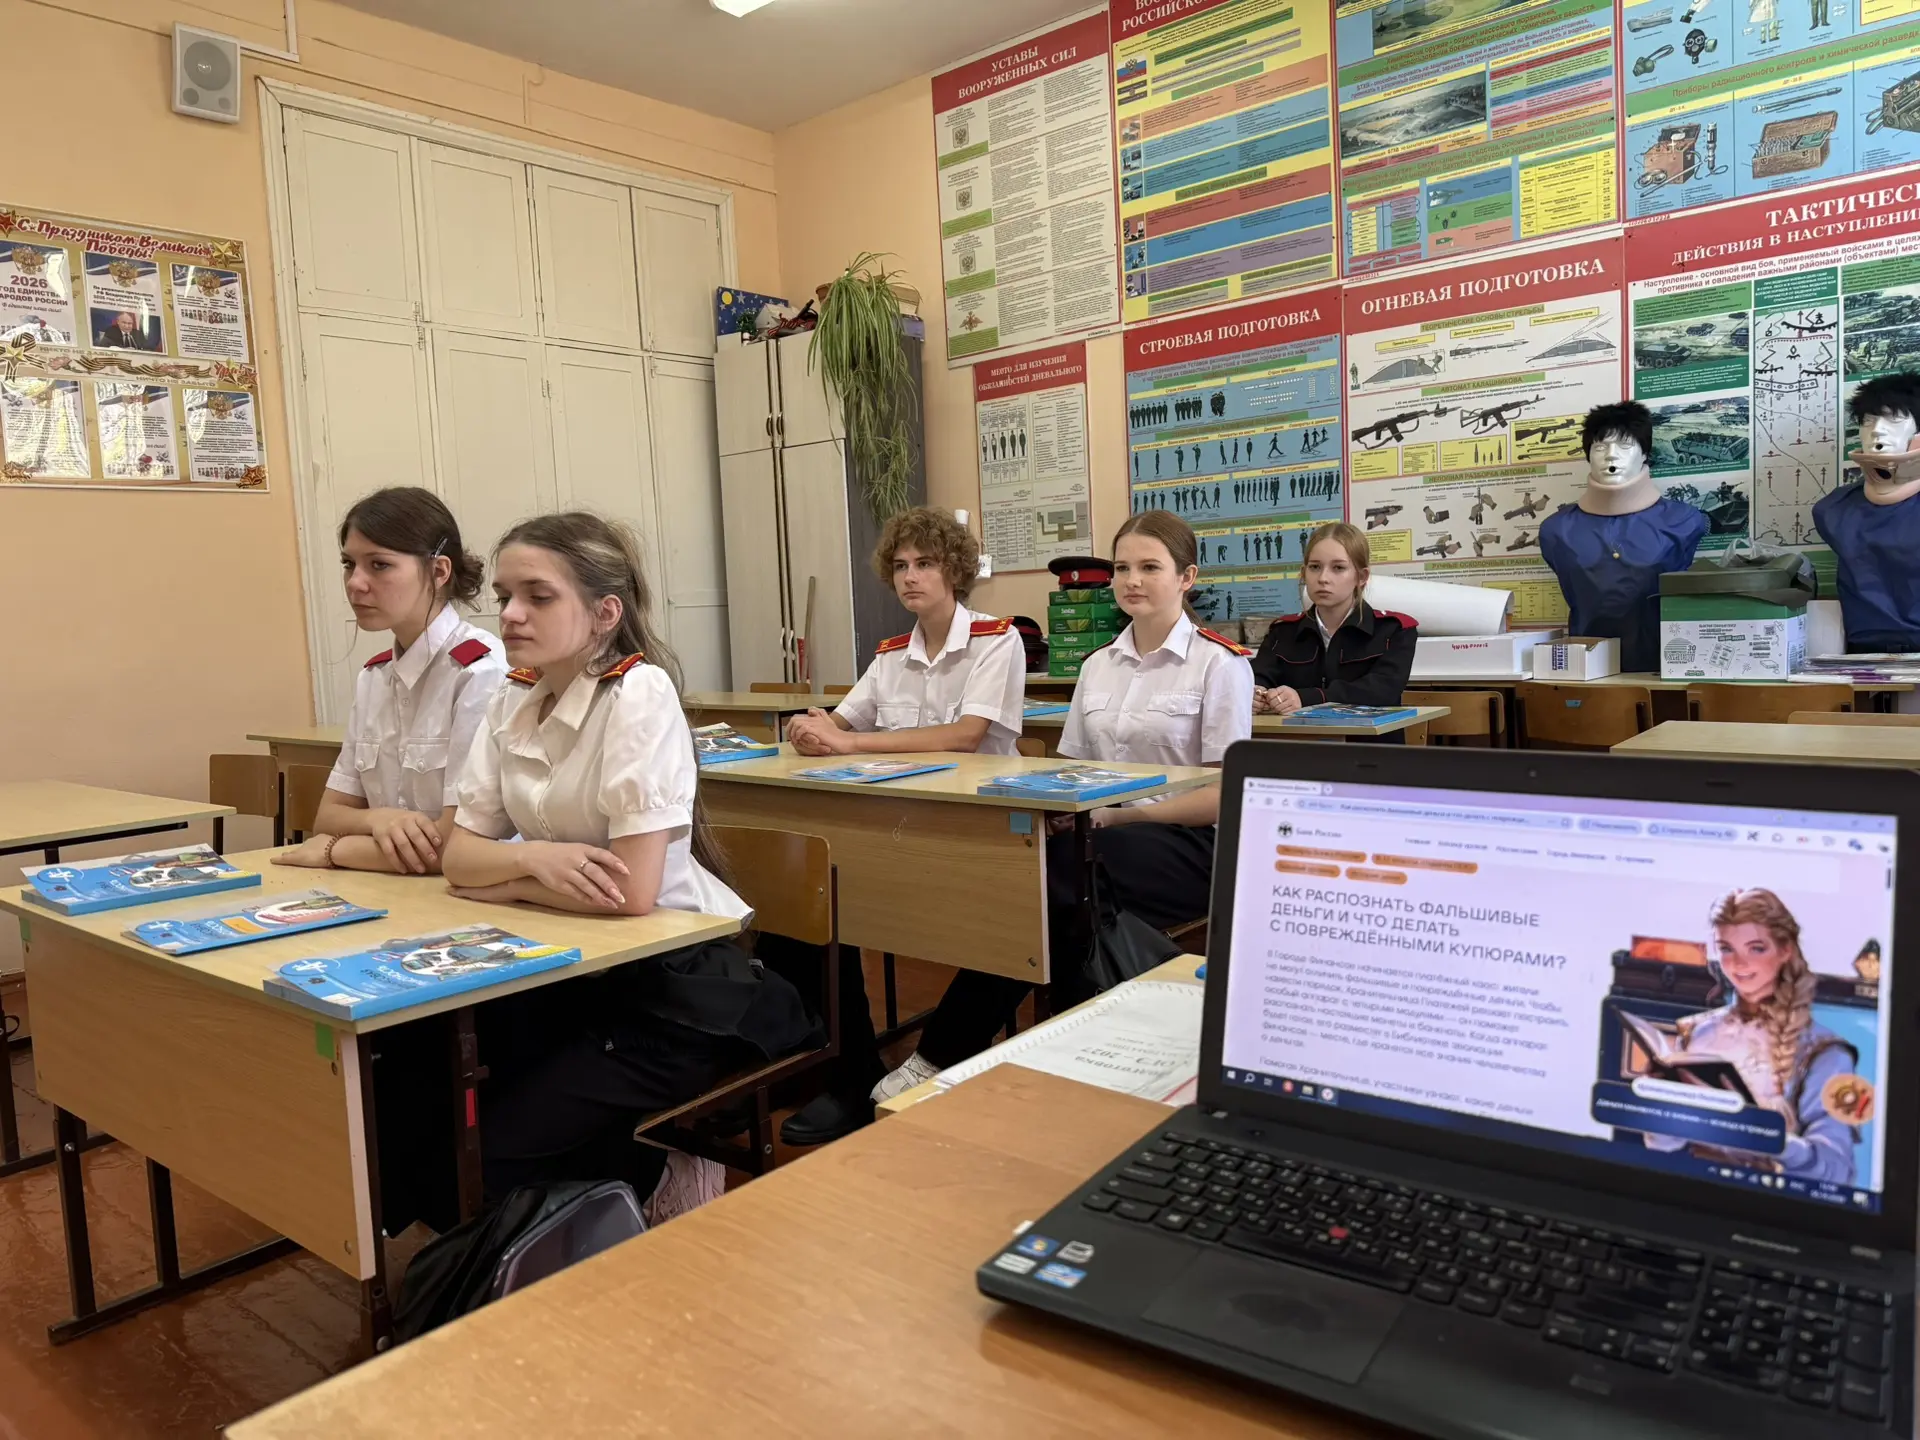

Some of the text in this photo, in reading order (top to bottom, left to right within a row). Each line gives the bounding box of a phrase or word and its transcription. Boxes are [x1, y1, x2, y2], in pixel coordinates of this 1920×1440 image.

[1121, 0, 1207, 31] РОССИЙСК
[958, 47, 1077, 99] ВООРУЖЕННЫХ СИЛ
[991, 46, 1039, 72] УСТАВЫ
[1672, 80, 1708, 97] Приборы
[1711, 64, 1774, 88] радиационного
[1819, 53, 1823, 62] и
[1826, 40, 1879, 61] химической
[37, 220, 135, 245] Праздником
[139, 234, 206, 257] Великой
[86, 239, 155, 259] Победы!
[1671, 238, 1763, 265] ДЕЙСТВИЯ
[1769, 234, 1781, 246] В
[1643, 273, 1692, 290] Наступление
[1700, 265, 1738, 280] основной
[1741, 262, 1755, 273] вид
[1758, 259, 1775, 270] боя,
[1778, 248, 1838, 266] применяемый
[1841, 240, 1882, 256] войсками
[1885, 239, 1891, 248] в
[1657, 279, 1702, 295] противника
[1705, 278, 1710, 287] и
[1712, 270, 1755, 286] овладения
[1758, 263, 1797, 278] важными
[1799, 255, 1841, 271] районами
[1844, 245, 1898, 263] (объектами)
[10, 275, 48, 289] 2026
[1361, 258, 1605, 315] ОГНЕВАЯ ПОДГОТОВКА
[35, 297, 68, 306] РОССИИ
[1140, 308, 1321, 355] СТРОЕВАЯ ПОДГОТОВКА
[1422, 316, 1474, 332] ТЕОРЕТИЧЕСКИЕ
[1476, 311, 1504, 324] ОСНОВЫ
[1506, 306, 1544, 319] СТРЕЛЬБЫ
[991, 354, 1067, 377] МЕСТО ДЛЯ ИЗУЧЕНИЯ
[1032, 365, 1082, 382] ДНЕВАЛЬНОГО
[1440, 376, 1522, 392] АВТОМАТ КАЛАШНИКОВА
[1428, 473, 1461, 483] НЕПОЛНАЯ
[1463, 470, 1498, 480] РАЗБОРКА
[1500, 467, 1536, 478] АВТОМАТА
[1271, 903, 1460, 938] ДЕНЬГИ И ЧТО ДЕЛАТЬ
[1272, 885, 1540, 928] КАК РАСПОЗНАТЬ ФАЛЬШИВЫЕ
[1270, 920, 1566, 970] С ПОВРЕЖДЁННЫМИ КУПЮРАМИ?
